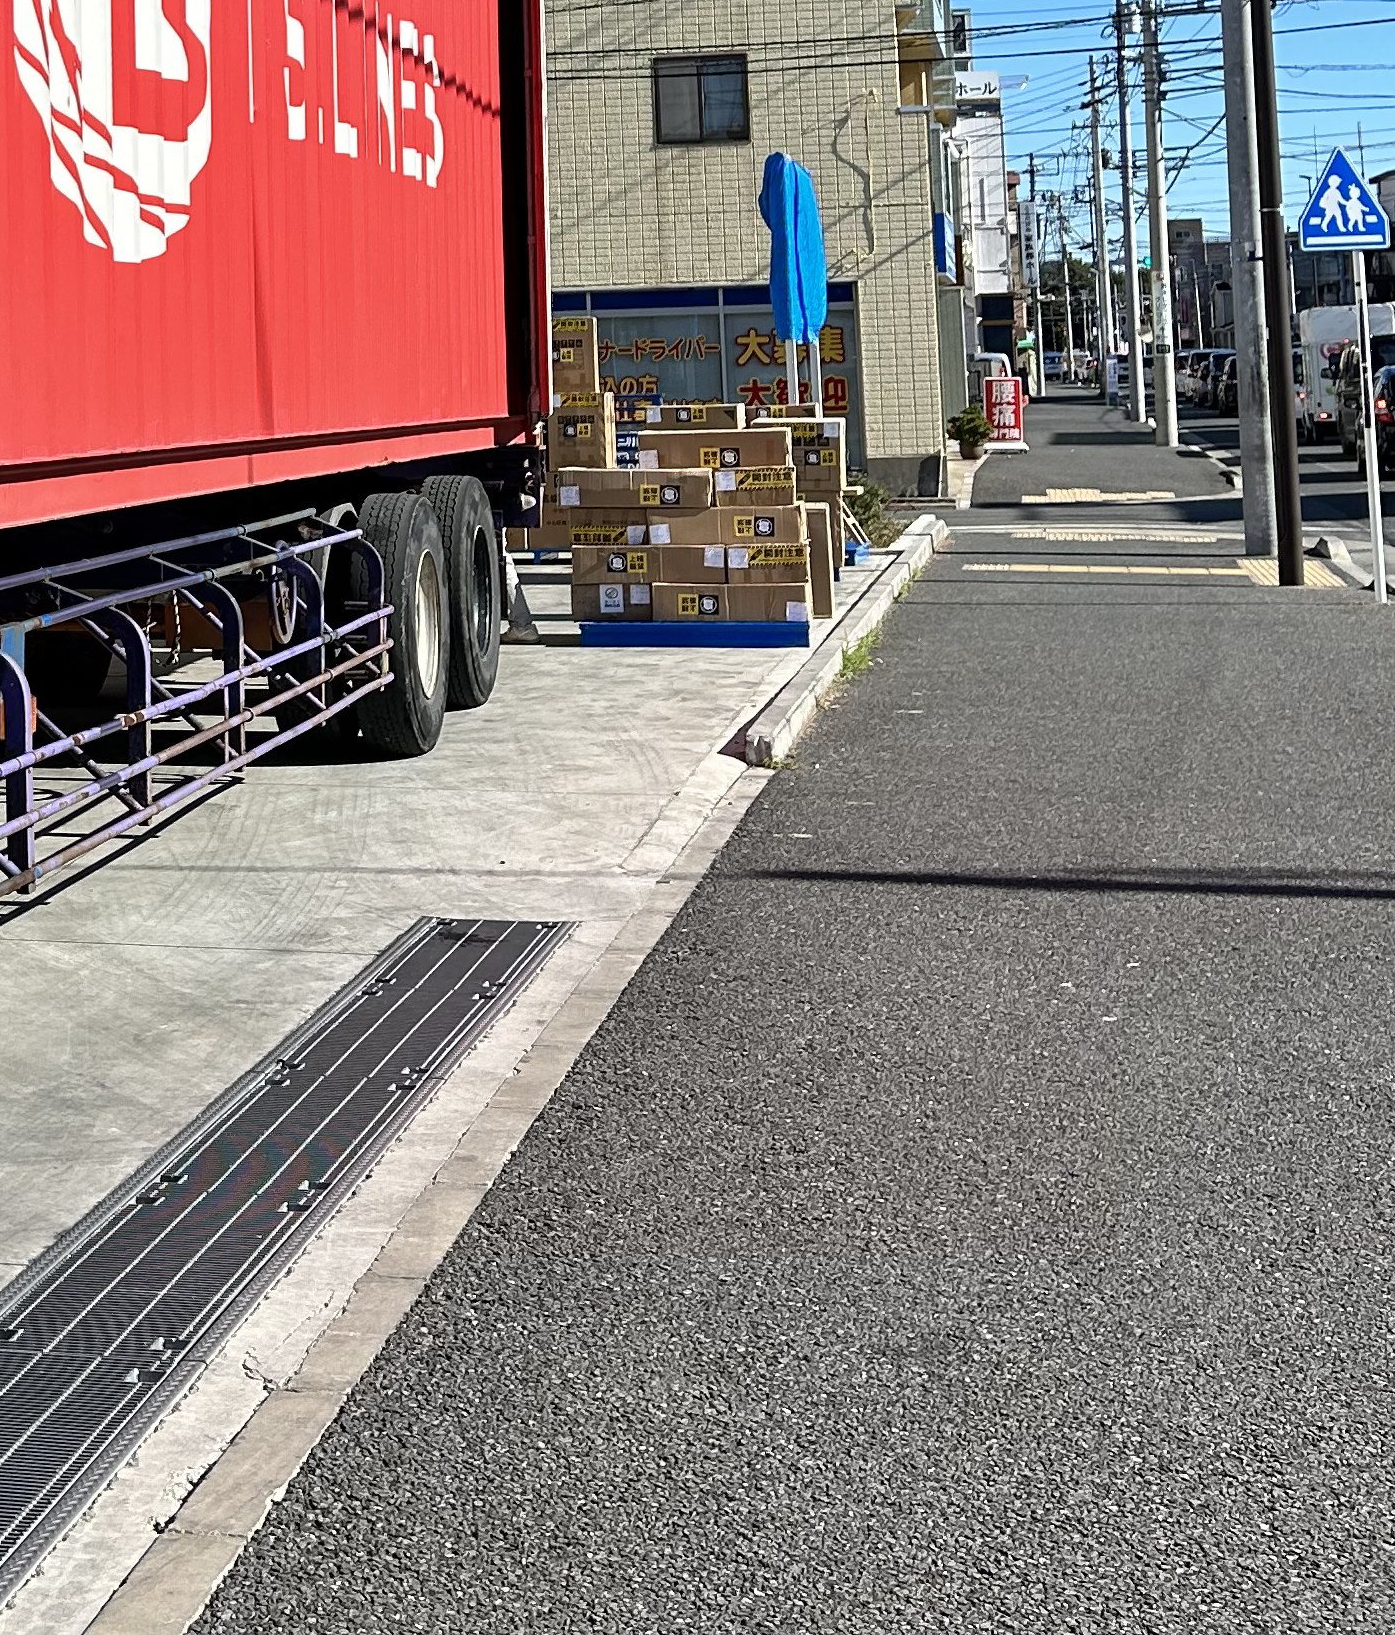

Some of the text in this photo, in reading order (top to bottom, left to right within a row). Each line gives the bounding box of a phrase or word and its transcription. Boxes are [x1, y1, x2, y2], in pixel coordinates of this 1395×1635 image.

[956, 81, 997, 96] ホール
[991, 381, 1016, 427] 腰痛
